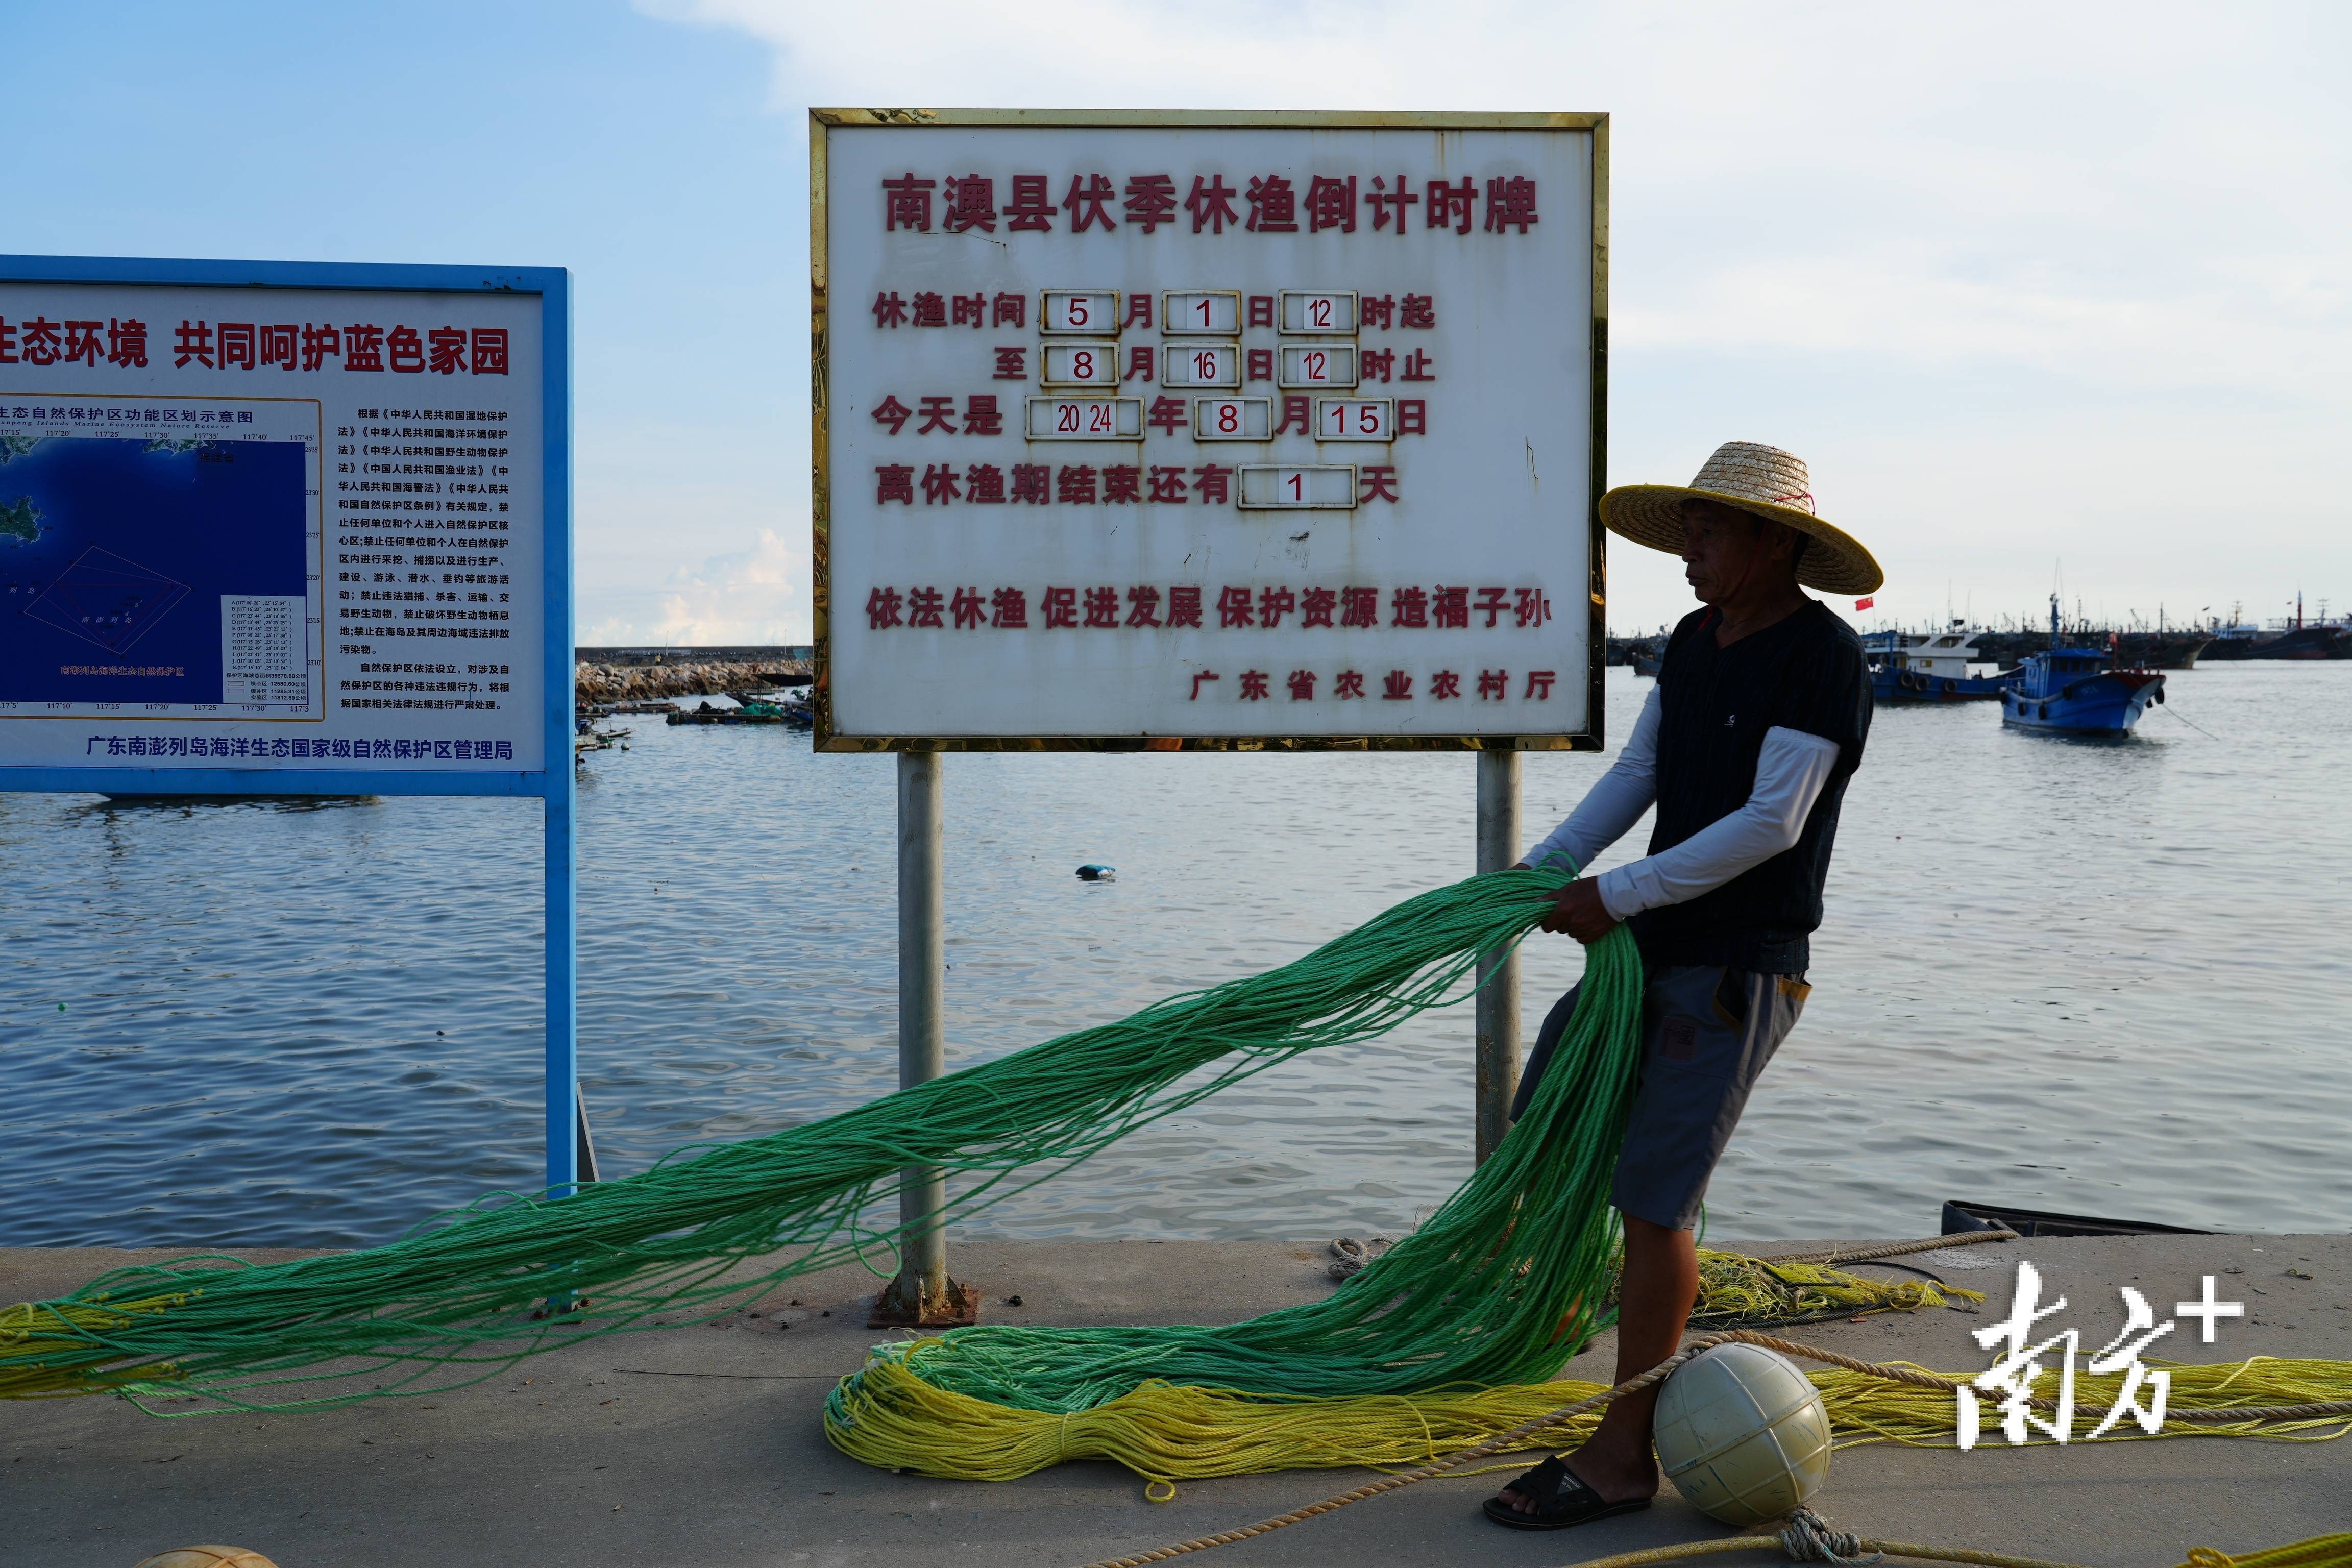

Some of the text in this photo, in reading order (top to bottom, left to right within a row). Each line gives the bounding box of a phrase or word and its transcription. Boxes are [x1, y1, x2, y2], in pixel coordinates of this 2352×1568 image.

[884, 173, 1539, 234] 南澳县伏季休渔倒计时牌
[873, 291, 1435, 330] 休渔时间 5 月 1 日 12 时起
[174, 320, 508, 374] 共同呵护蓝色家园
[993, 346, 1436, 383] 至 8 月 16 日 12 时止
[0, 406, 254, 423] 生态自然保护区功能区划示意图
[357, 408, 508, 422] 根据《中华人民共和国湿地保护
[873, 395, 1002, 435] 今天是
[1149, 395, 1188, 436] 年
[1218, 404, 1239, 433] 8
[1277, 392, 1311, 435] 月
[1332, 405, 1379, 434] 15
[1398, 399, 1427, 435] 日
[108, 422, 157, 430] Ecosystem
[337, 426, 508, 440] 法》《中华人民共和国海洋环境保护
[338, 444, 508, 458] 法》《中华人民共和国野生动物保护
[338, 462, 508, 477] 法》《中国人民共和国渔业法》《中
[338, 481, 509, 494] 华人民共和国海警法》《中华人民共
[876, 463, 1399, 505] 离休渔期结束还有 1 天
[338, 499, 509, 512] 和国自然保护区条例》有关规定，禁
[338, 517, 509, 530] 止任何单位和个人进入自然保护区核
[338, 535, 509, 549] 心区;禁止任何单位和个人在自然保护
[339, 554, 504, 566] 区内进行采挖、捕捞以及进行生产、
[339, 572, 509, 585] 建设、游泳、潜水、垂钓等旅游活
[339, 590, 509, 603] 动；禁止违法猎捕、杀害、运输、交
[867, 584, 1552, 629] 依法休渔 促进发展 保护资源 造福子孙
[339, 608, 509, 621] 易野生动物，禁止破坏野生动物栖息
[339, 626, 510, 639] 地;禁止在海岛及其周边海域违法排放
[339, 644, 376, 655] 污染物。
[60, 665, 184, 677] 南澎列岛海洋生态自然保护区
[361, 663, 509, 675] 自然保护区依法设立，对涉及自
[340, 680, 510, 693] 然保护区的各种违法违规行为，将根
[1191, 669, 1556, 701] 广东省农业农村厅
[340, 697, 501, 710] 据国家相关法律法规进行严肃处理。
[86, 735, 512, 761] 广东南澎列岛海洋生态国家级自然保护区管理局
